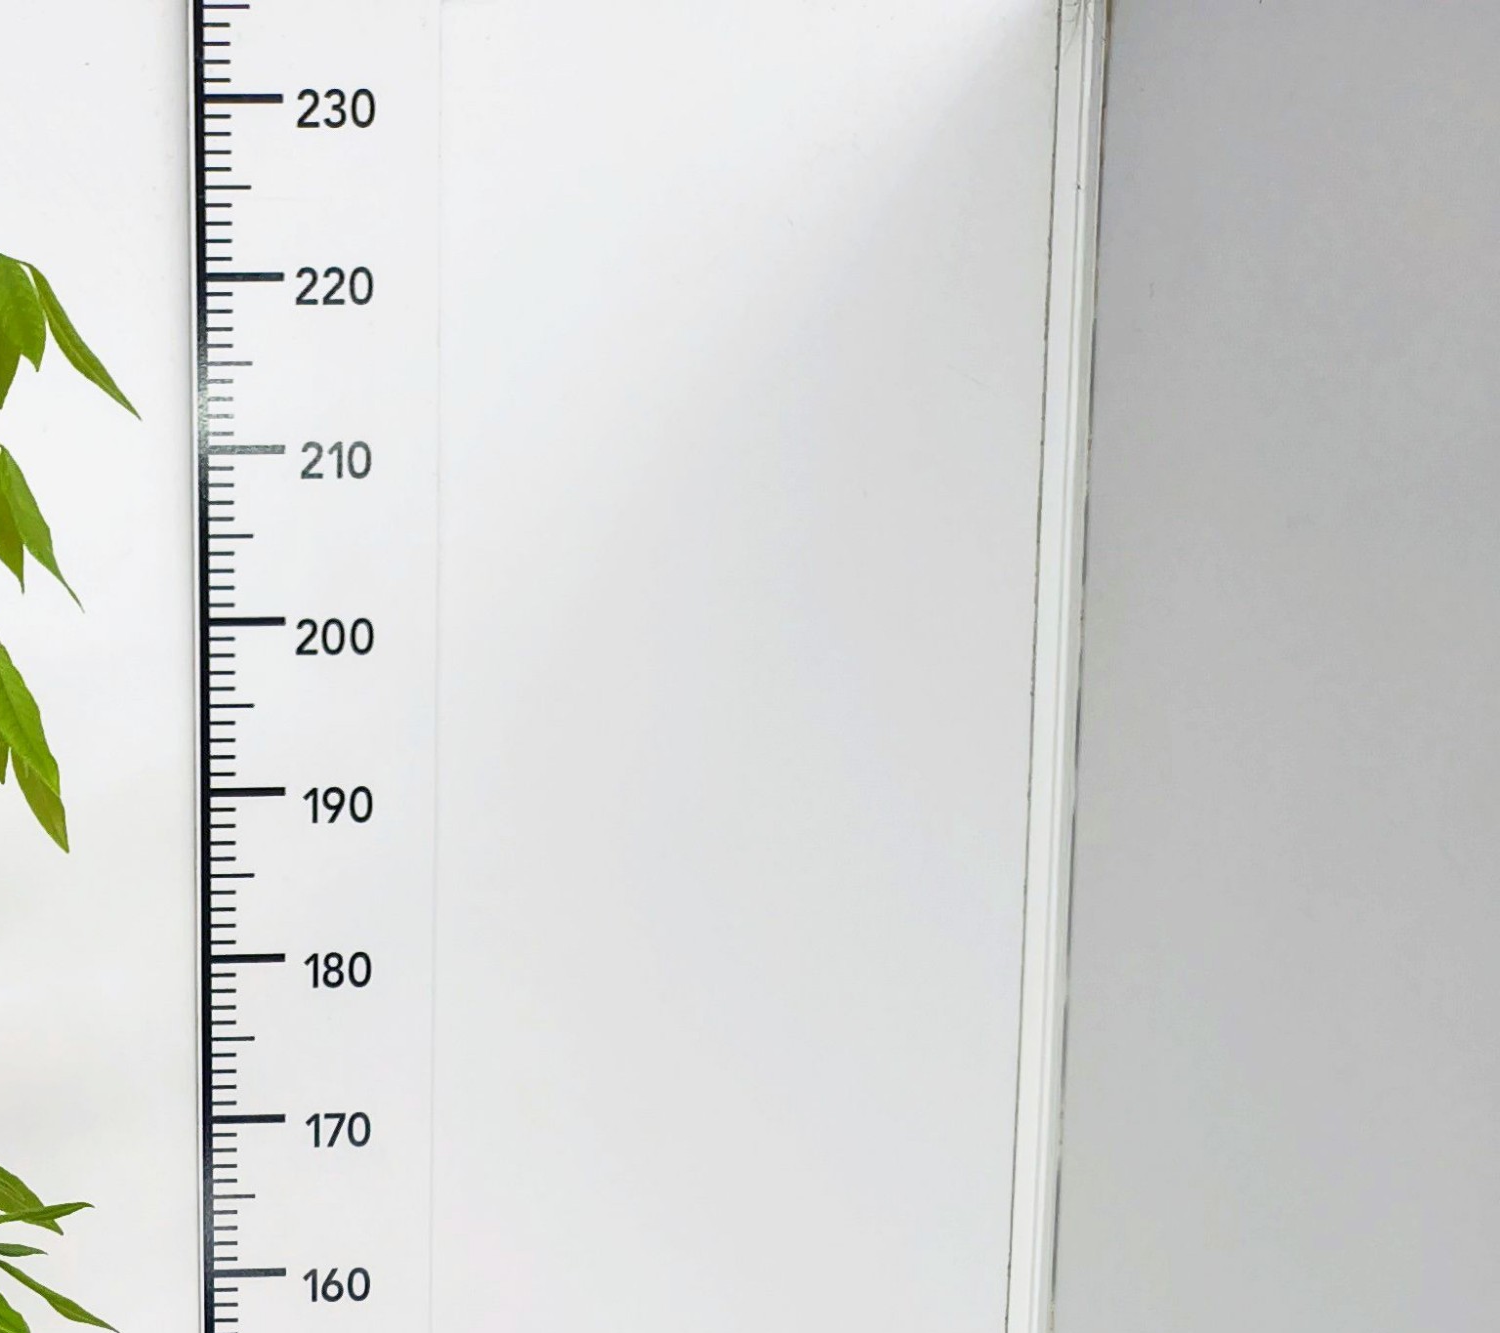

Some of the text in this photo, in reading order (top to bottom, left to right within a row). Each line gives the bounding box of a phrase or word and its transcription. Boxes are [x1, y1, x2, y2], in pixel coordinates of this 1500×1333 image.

[297, 88, 376, 129] 230
[295, 266, 374, 306] 220
[301, 441, 372, 479] 210
[295, 617, 374, 656] 200
[302, 785, 373, 824] 190
[304, 951, 372, 989] 180
[305, 1111, 371, 1148] 170
[303, 1267, 371, 1303] 160
